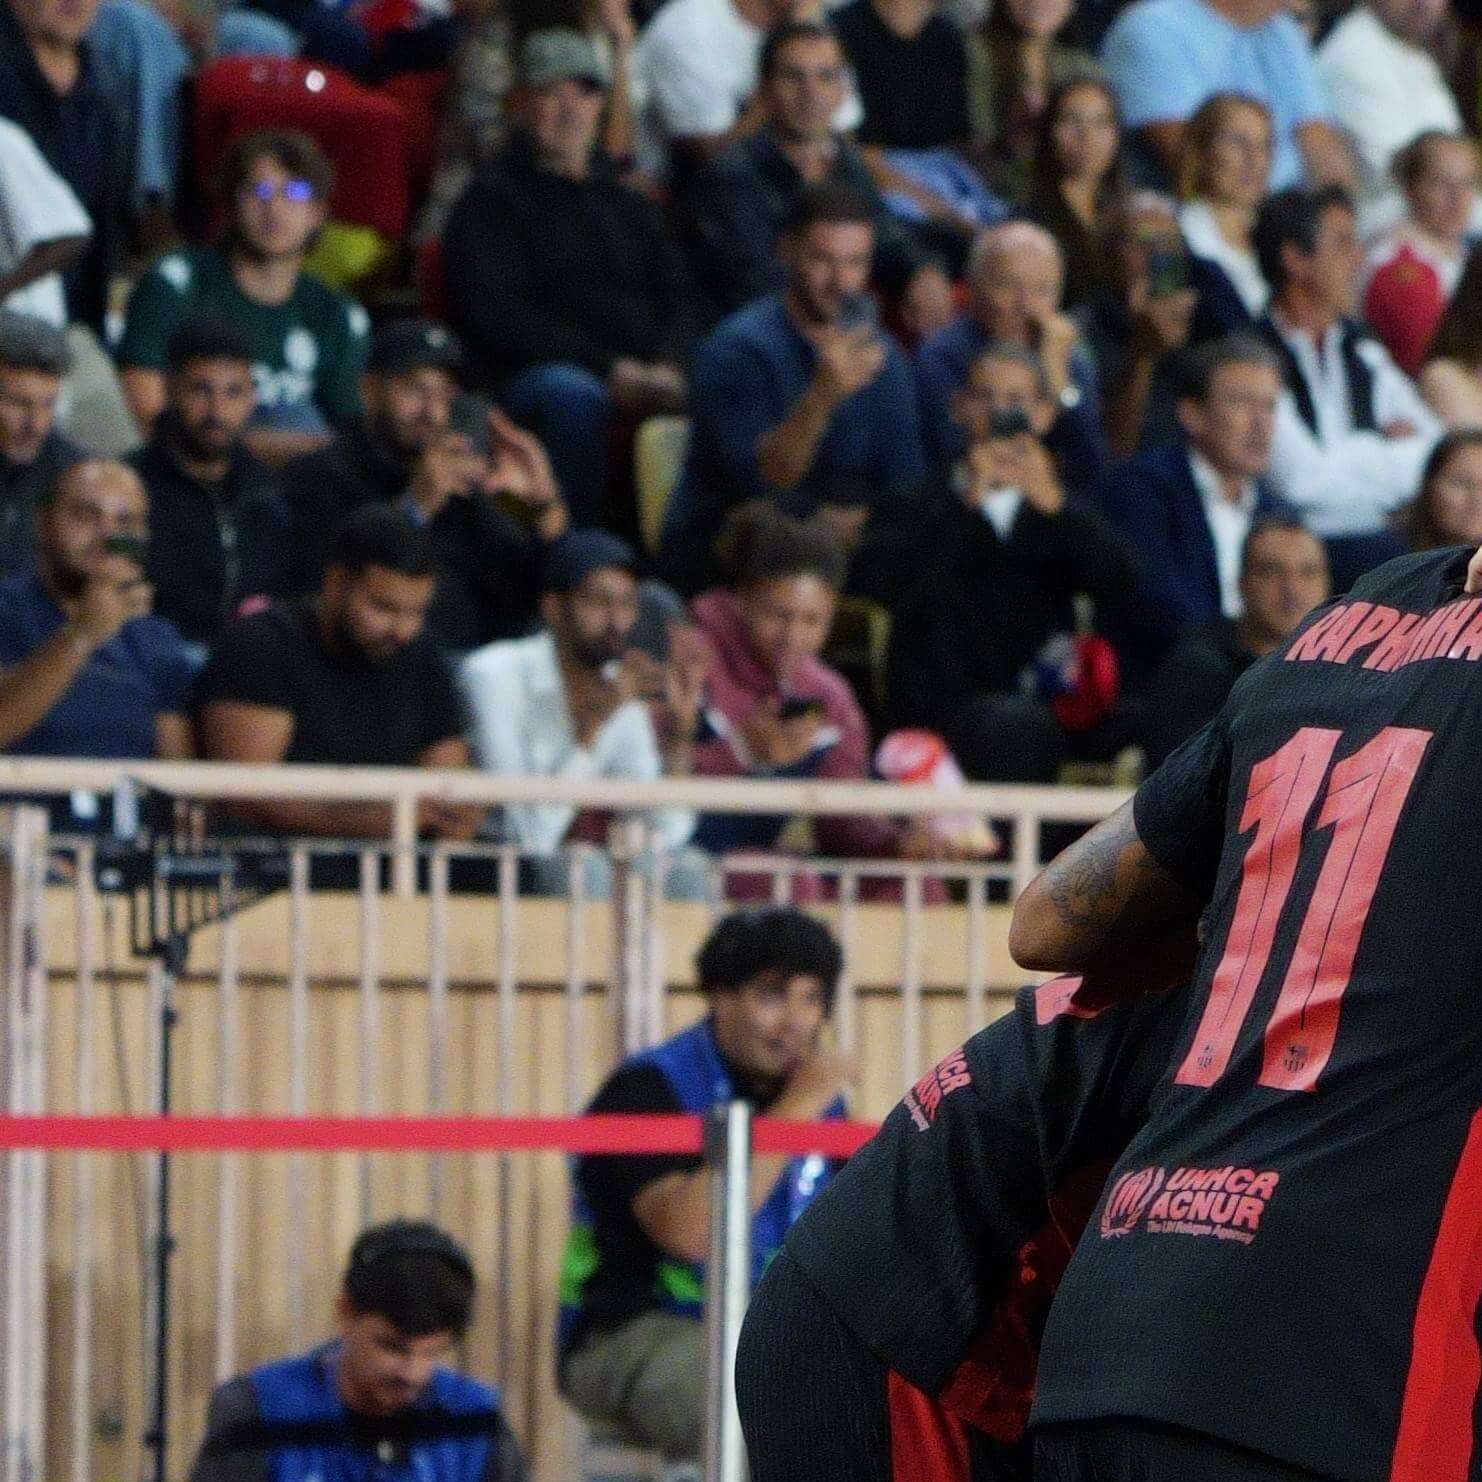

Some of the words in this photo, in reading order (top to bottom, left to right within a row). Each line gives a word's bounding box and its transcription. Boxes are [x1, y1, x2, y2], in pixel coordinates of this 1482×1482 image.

[1174, 726, 1434, 1093] 11
[1165, 1165, 1280, 1200] UNHCR
[1150, 1190, 1265, 1229] ACNUR
